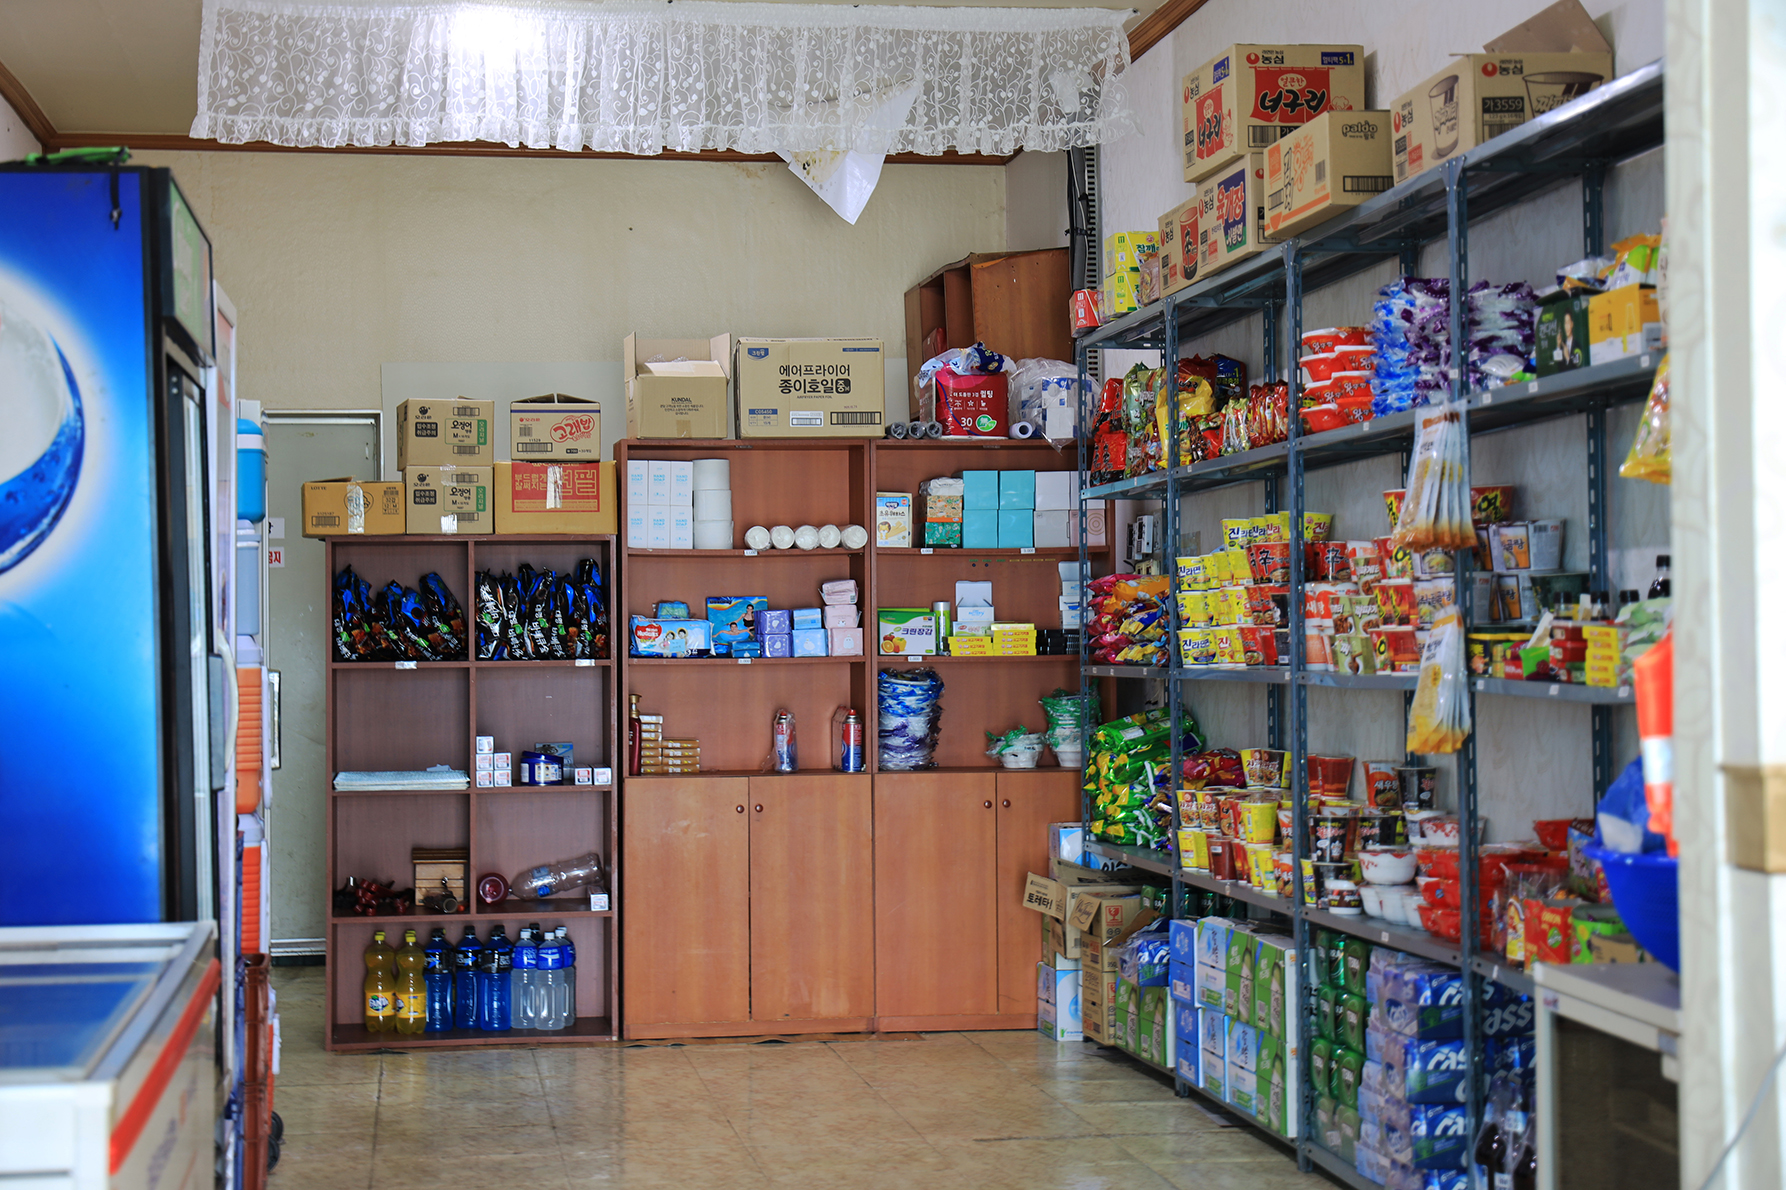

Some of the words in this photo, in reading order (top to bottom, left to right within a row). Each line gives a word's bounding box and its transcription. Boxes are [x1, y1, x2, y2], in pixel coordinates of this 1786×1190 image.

[1261, 55, 1284, 65] 농심
[1499, 65, 1523, 76] 농심
[1280, 76, 1305, 88] 얼큰한
[1190, 82, 1199, 100] 농심
[1259, 88, 1326, 114] 너구리
[1484, 99, 1523, 112] 가3559
[1402, 108, 1413, 128] 농심
[1199, 110, 1222, 150] 너구리
[1342, 121, 1378, 137] paldo
[1204, 195, 1214, 214] 농심
[1216, 181, 1245, 226] 육개장
[1165, 227, 1174, 244] 농심
[779, 364, 850, 377] 에어프라이어
[778, 378, 834, 395] 종이호일
[451, 420, 472, 431] 오징어
[553, 418, 592, 440] 고래밥
[961, 417, 973, 427] 30
[450, 487, 471, 498] 오징어
[1178, 565, 1201, 579] 진라면
[901, 627, 933, 636] 크린장갑
[1182, 638, 1210, 652] 진라면
[1026, 892, 1054, 911] 토레타!
